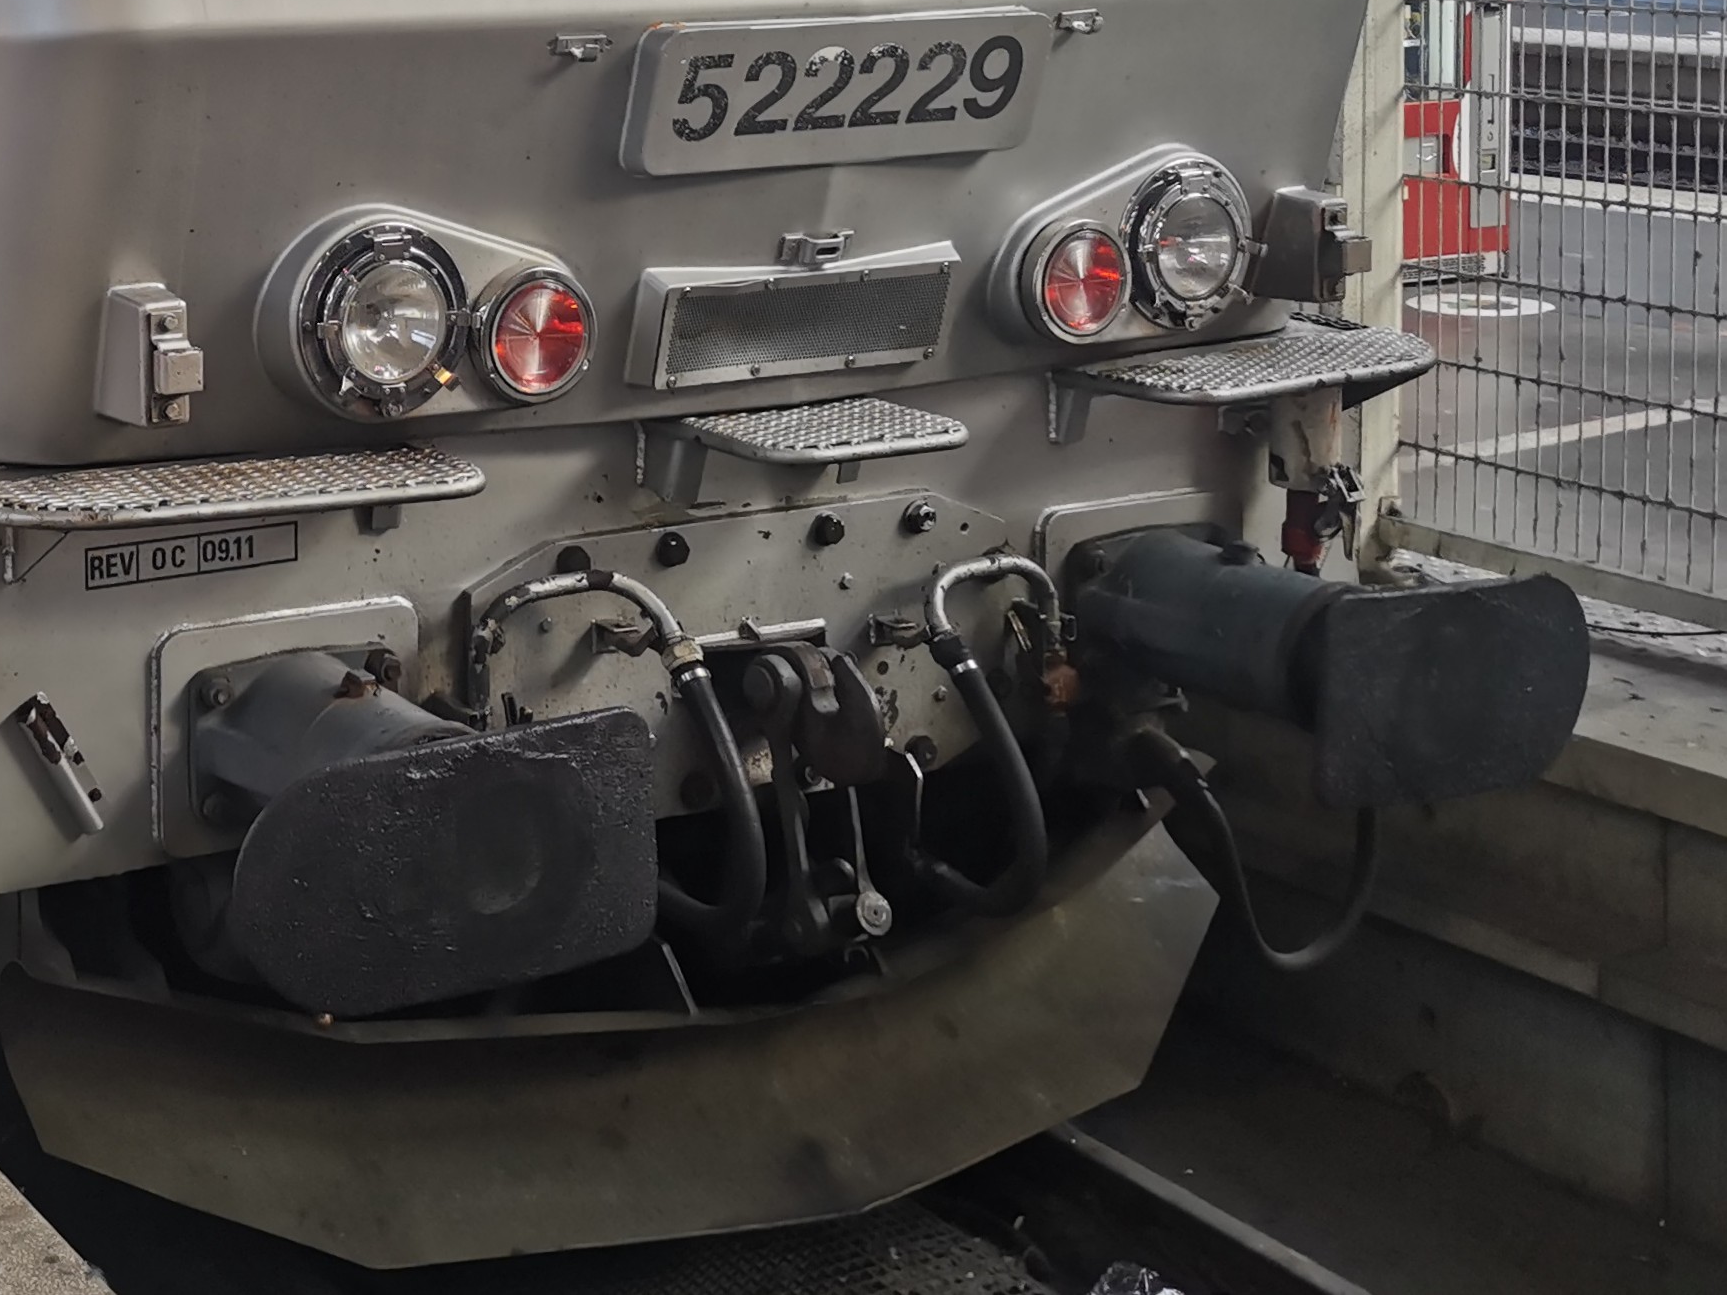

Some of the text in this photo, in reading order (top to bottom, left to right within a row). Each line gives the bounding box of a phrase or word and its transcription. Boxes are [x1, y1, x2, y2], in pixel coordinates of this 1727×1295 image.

[672, 34, 1024, 142] 522229
[89, 551, 135, 581] REV
[202, 534, 255, 563] 09.11
